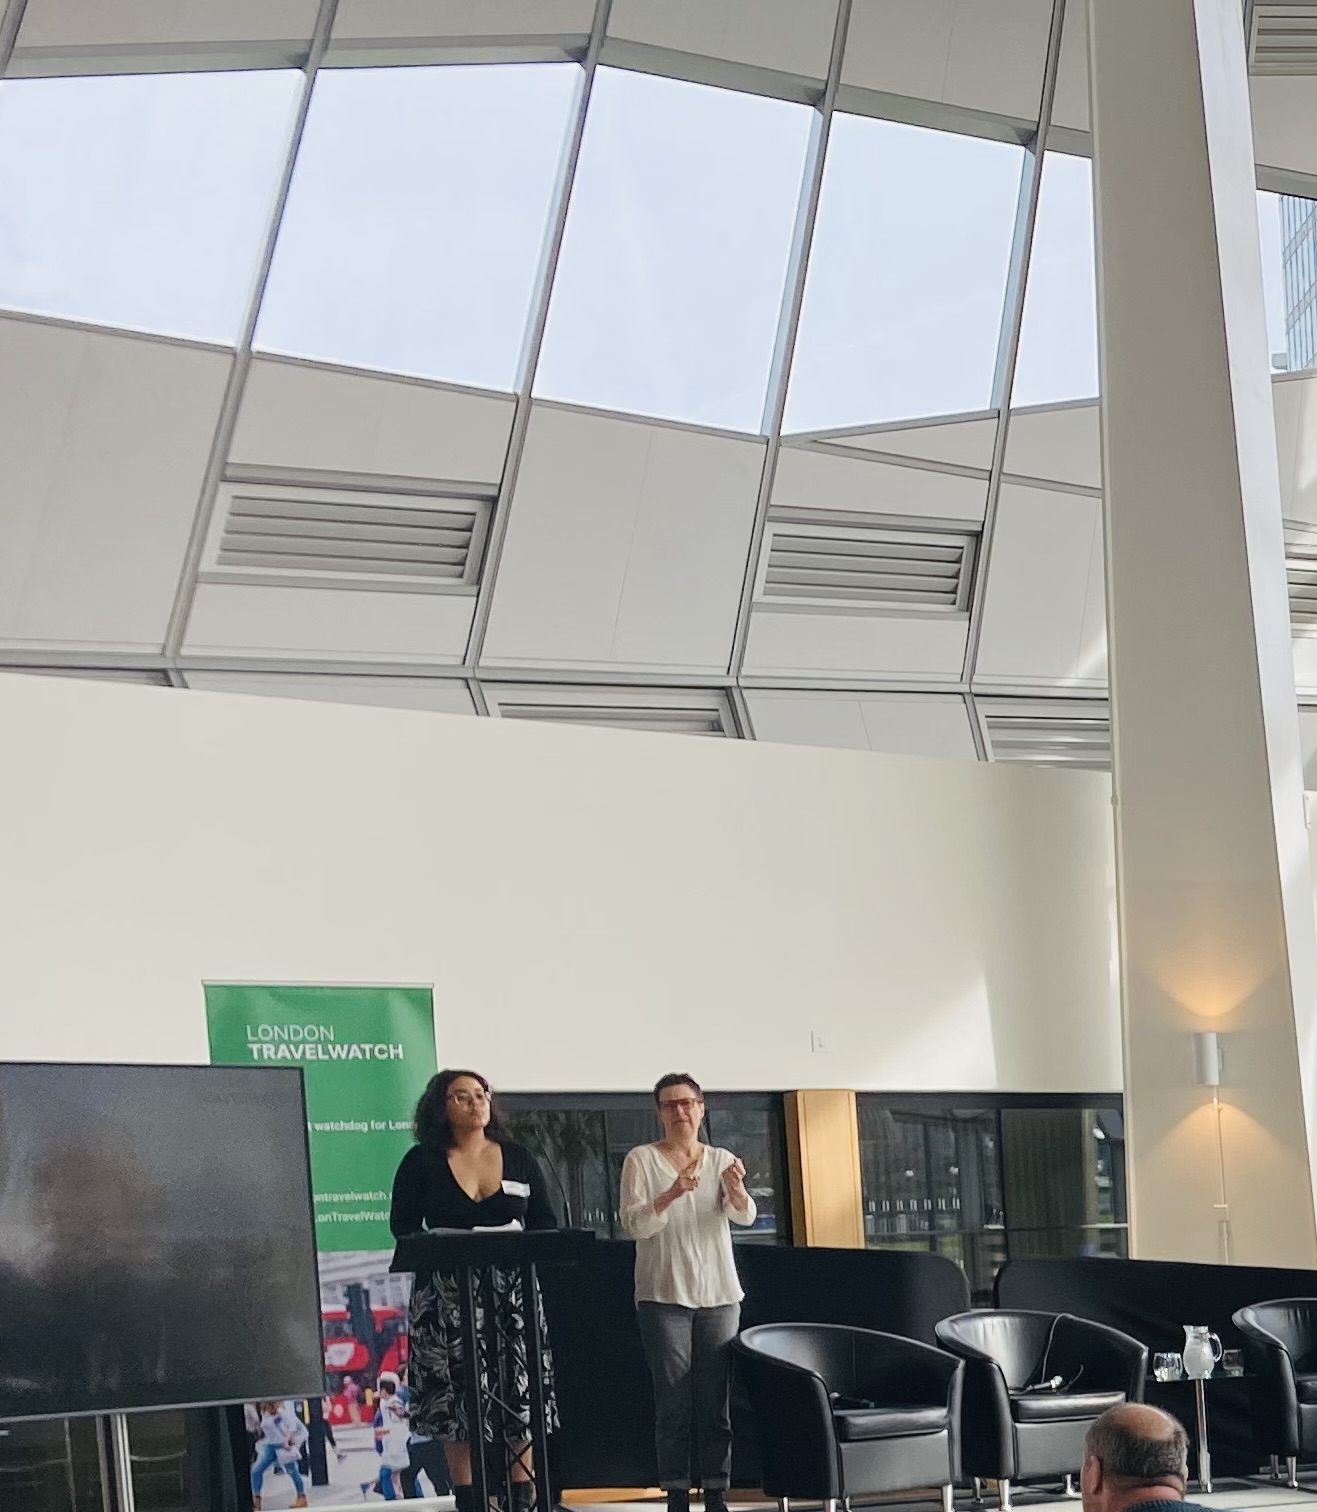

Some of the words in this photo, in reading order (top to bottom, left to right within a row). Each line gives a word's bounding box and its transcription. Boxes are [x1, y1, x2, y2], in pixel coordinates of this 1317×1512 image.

[246, 1024, 335, 1041] LONDON
[248, 1043, 404, 1060] TRAVELWATCH
[314, 1120, 368, 1133] watchdog
[370, 1119, 387, 1131] for
